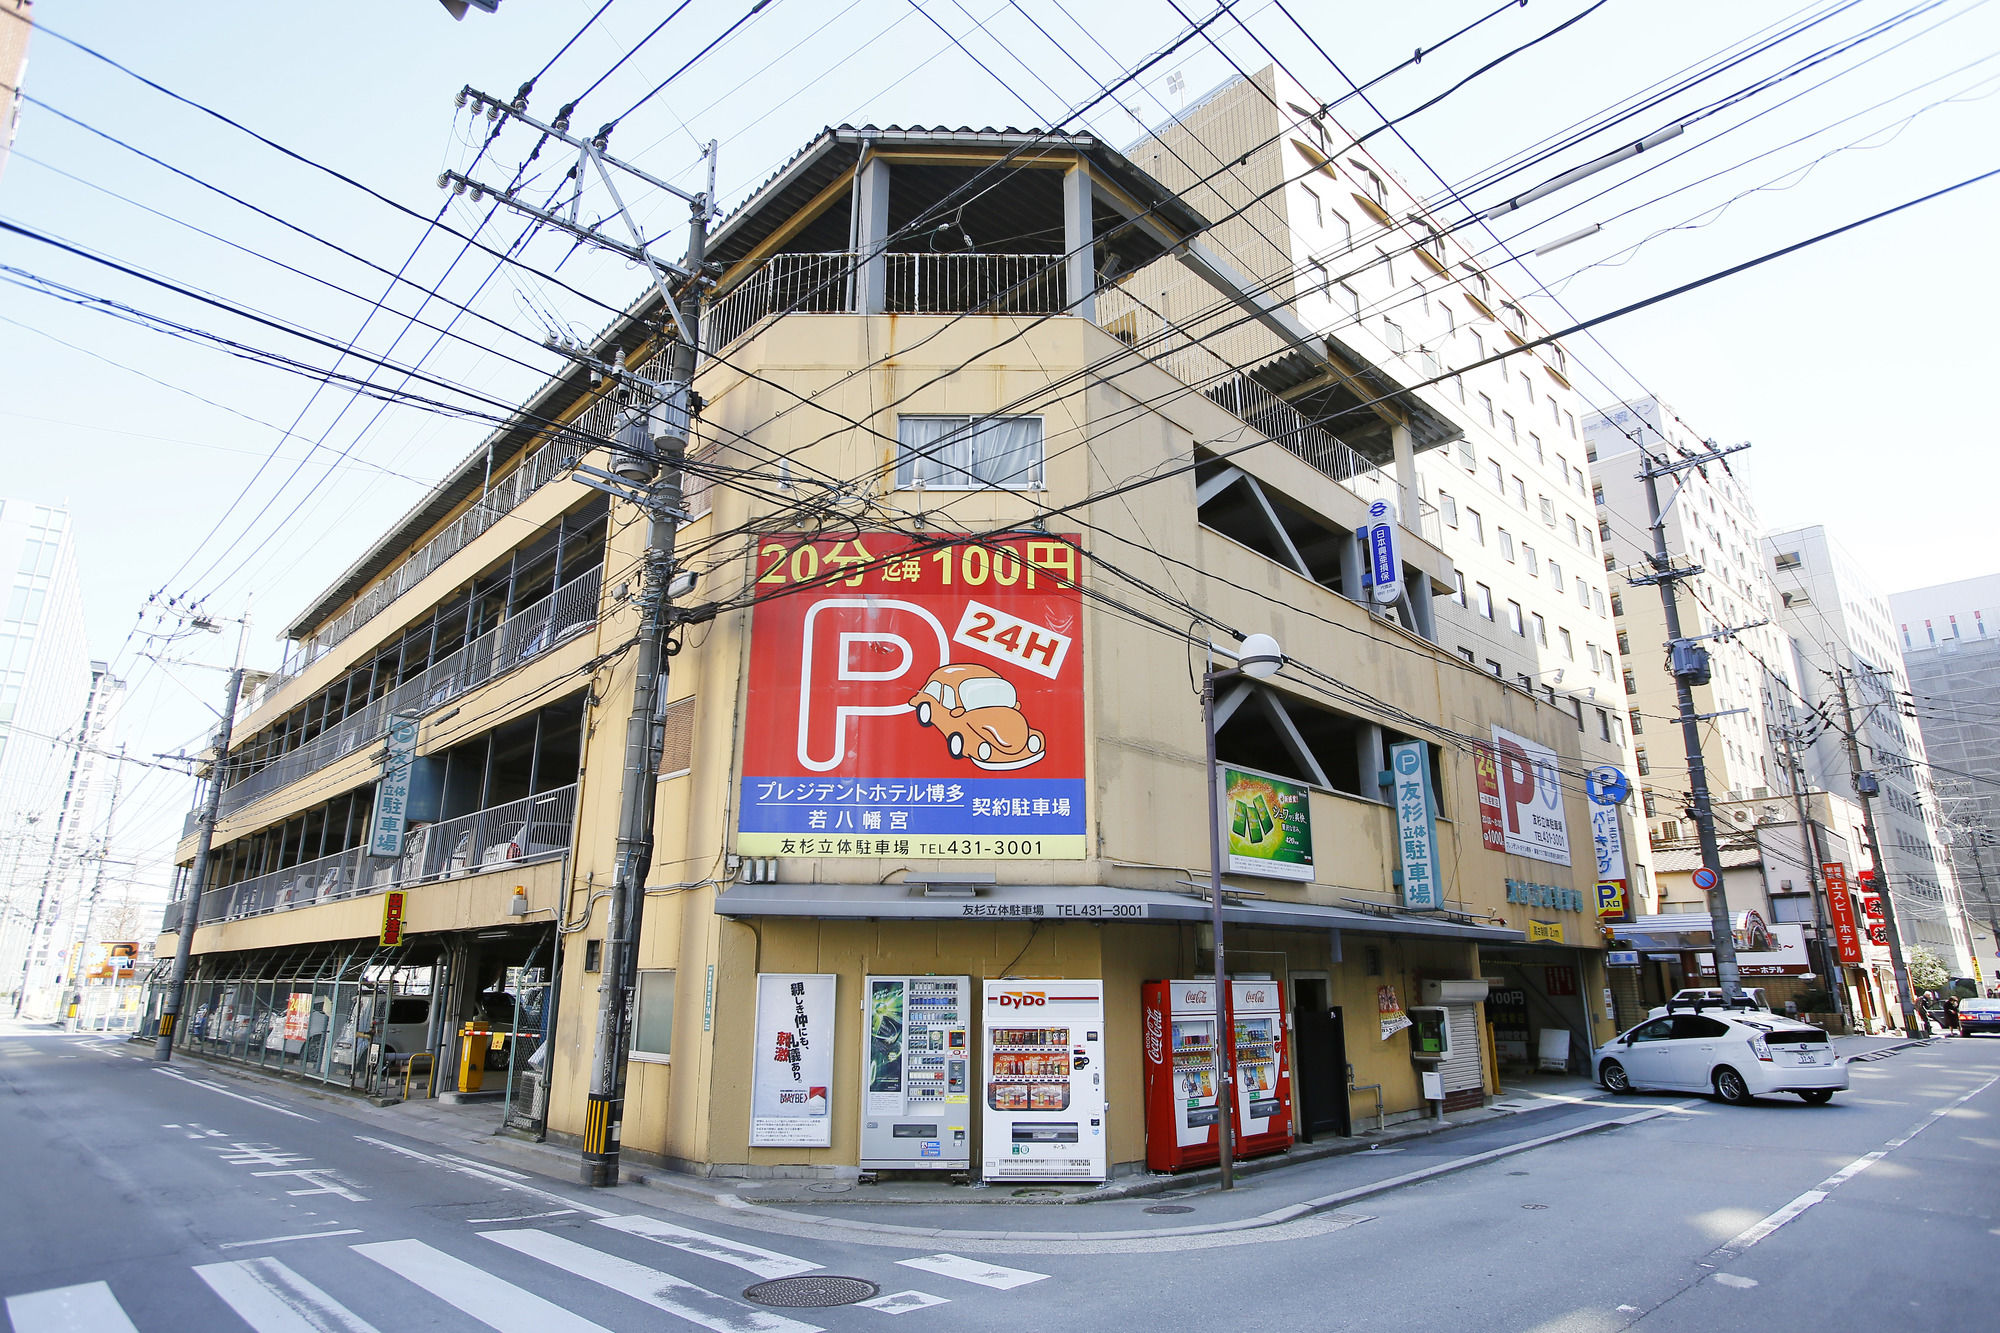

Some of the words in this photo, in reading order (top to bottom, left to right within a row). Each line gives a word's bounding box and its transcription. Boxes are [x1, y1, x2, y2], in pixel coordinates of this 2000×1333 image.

[758, 539, 875, 587] 20分
[932, 541, 1075, 590] 100円
[964, 611, 1060, 668] 24H
[797, 599, 950, 772] P
[1401, 754, 1417, 772] P
[1498, 736, 1534, 835] P
[1591, 768, 1618, 796] P
[757, 781, 965, 803] プレジデントホテル博多
[972, 797, 1071, 817] 契約駐車場
[808, 810, 909, 830] 若八幡宮
[780, 838, 909, 855] 友杉立体駐車場
[919, 840, 1042, 855] TEL431-3001
[1400, 780, 1430, 904] 友杉立体駐車場
[1593, 812, 1612, 874] パーキング
[962, 904, 1044, 916] 友杉立体駐車場
[1597, 885, 1617, 908] P
[1605, 900, 1621, 908] 入口
[790, 981, 809, 1050] 親しき仲にも、
[1000, 995, 1045, 1009] DyDo
